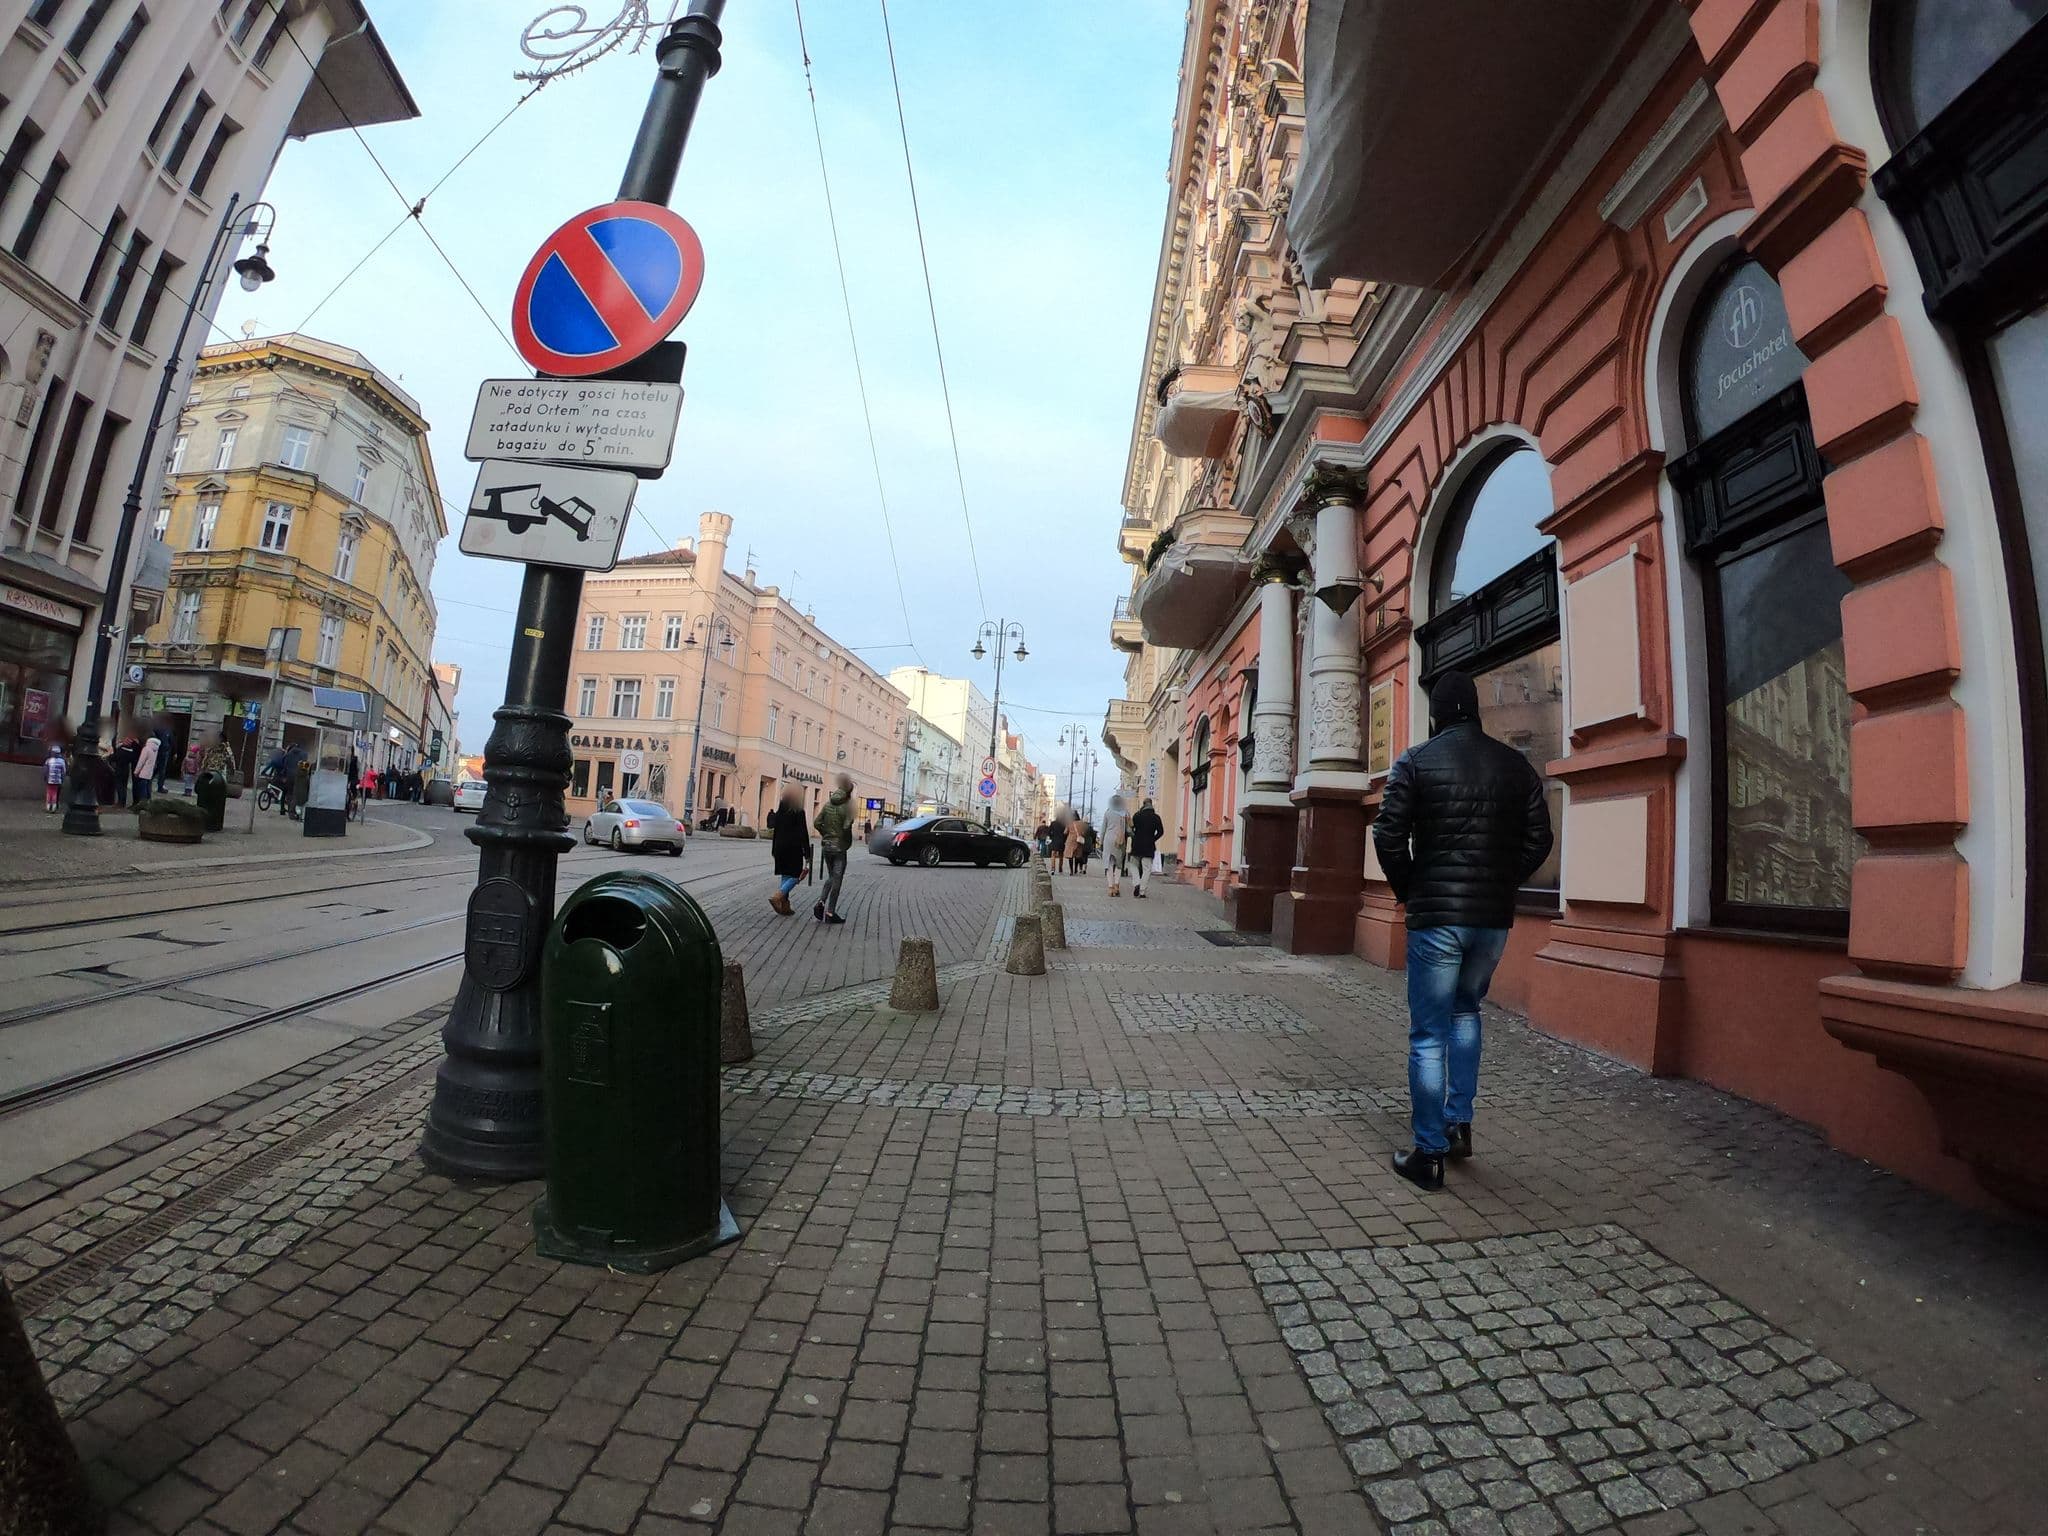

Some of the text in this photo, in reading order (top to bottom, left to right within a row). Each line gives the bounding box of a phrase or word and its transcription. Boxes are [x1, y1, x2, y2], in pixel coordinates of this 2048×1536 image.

[1717, 328, 1788, 400] focushotel
[490, 386, 669, 402] Nie dotyczy gości hotelu
[592, 408, 610, 417] na
[616, 409, 647, 419] czas
[489, 421, 655, 438] załadunku i wyładunku
[497, 438, 635, 456] bagażu do 5 min.
[571, 735, 644, 750] GALERIA
[983, 762, 994, 772] 40
